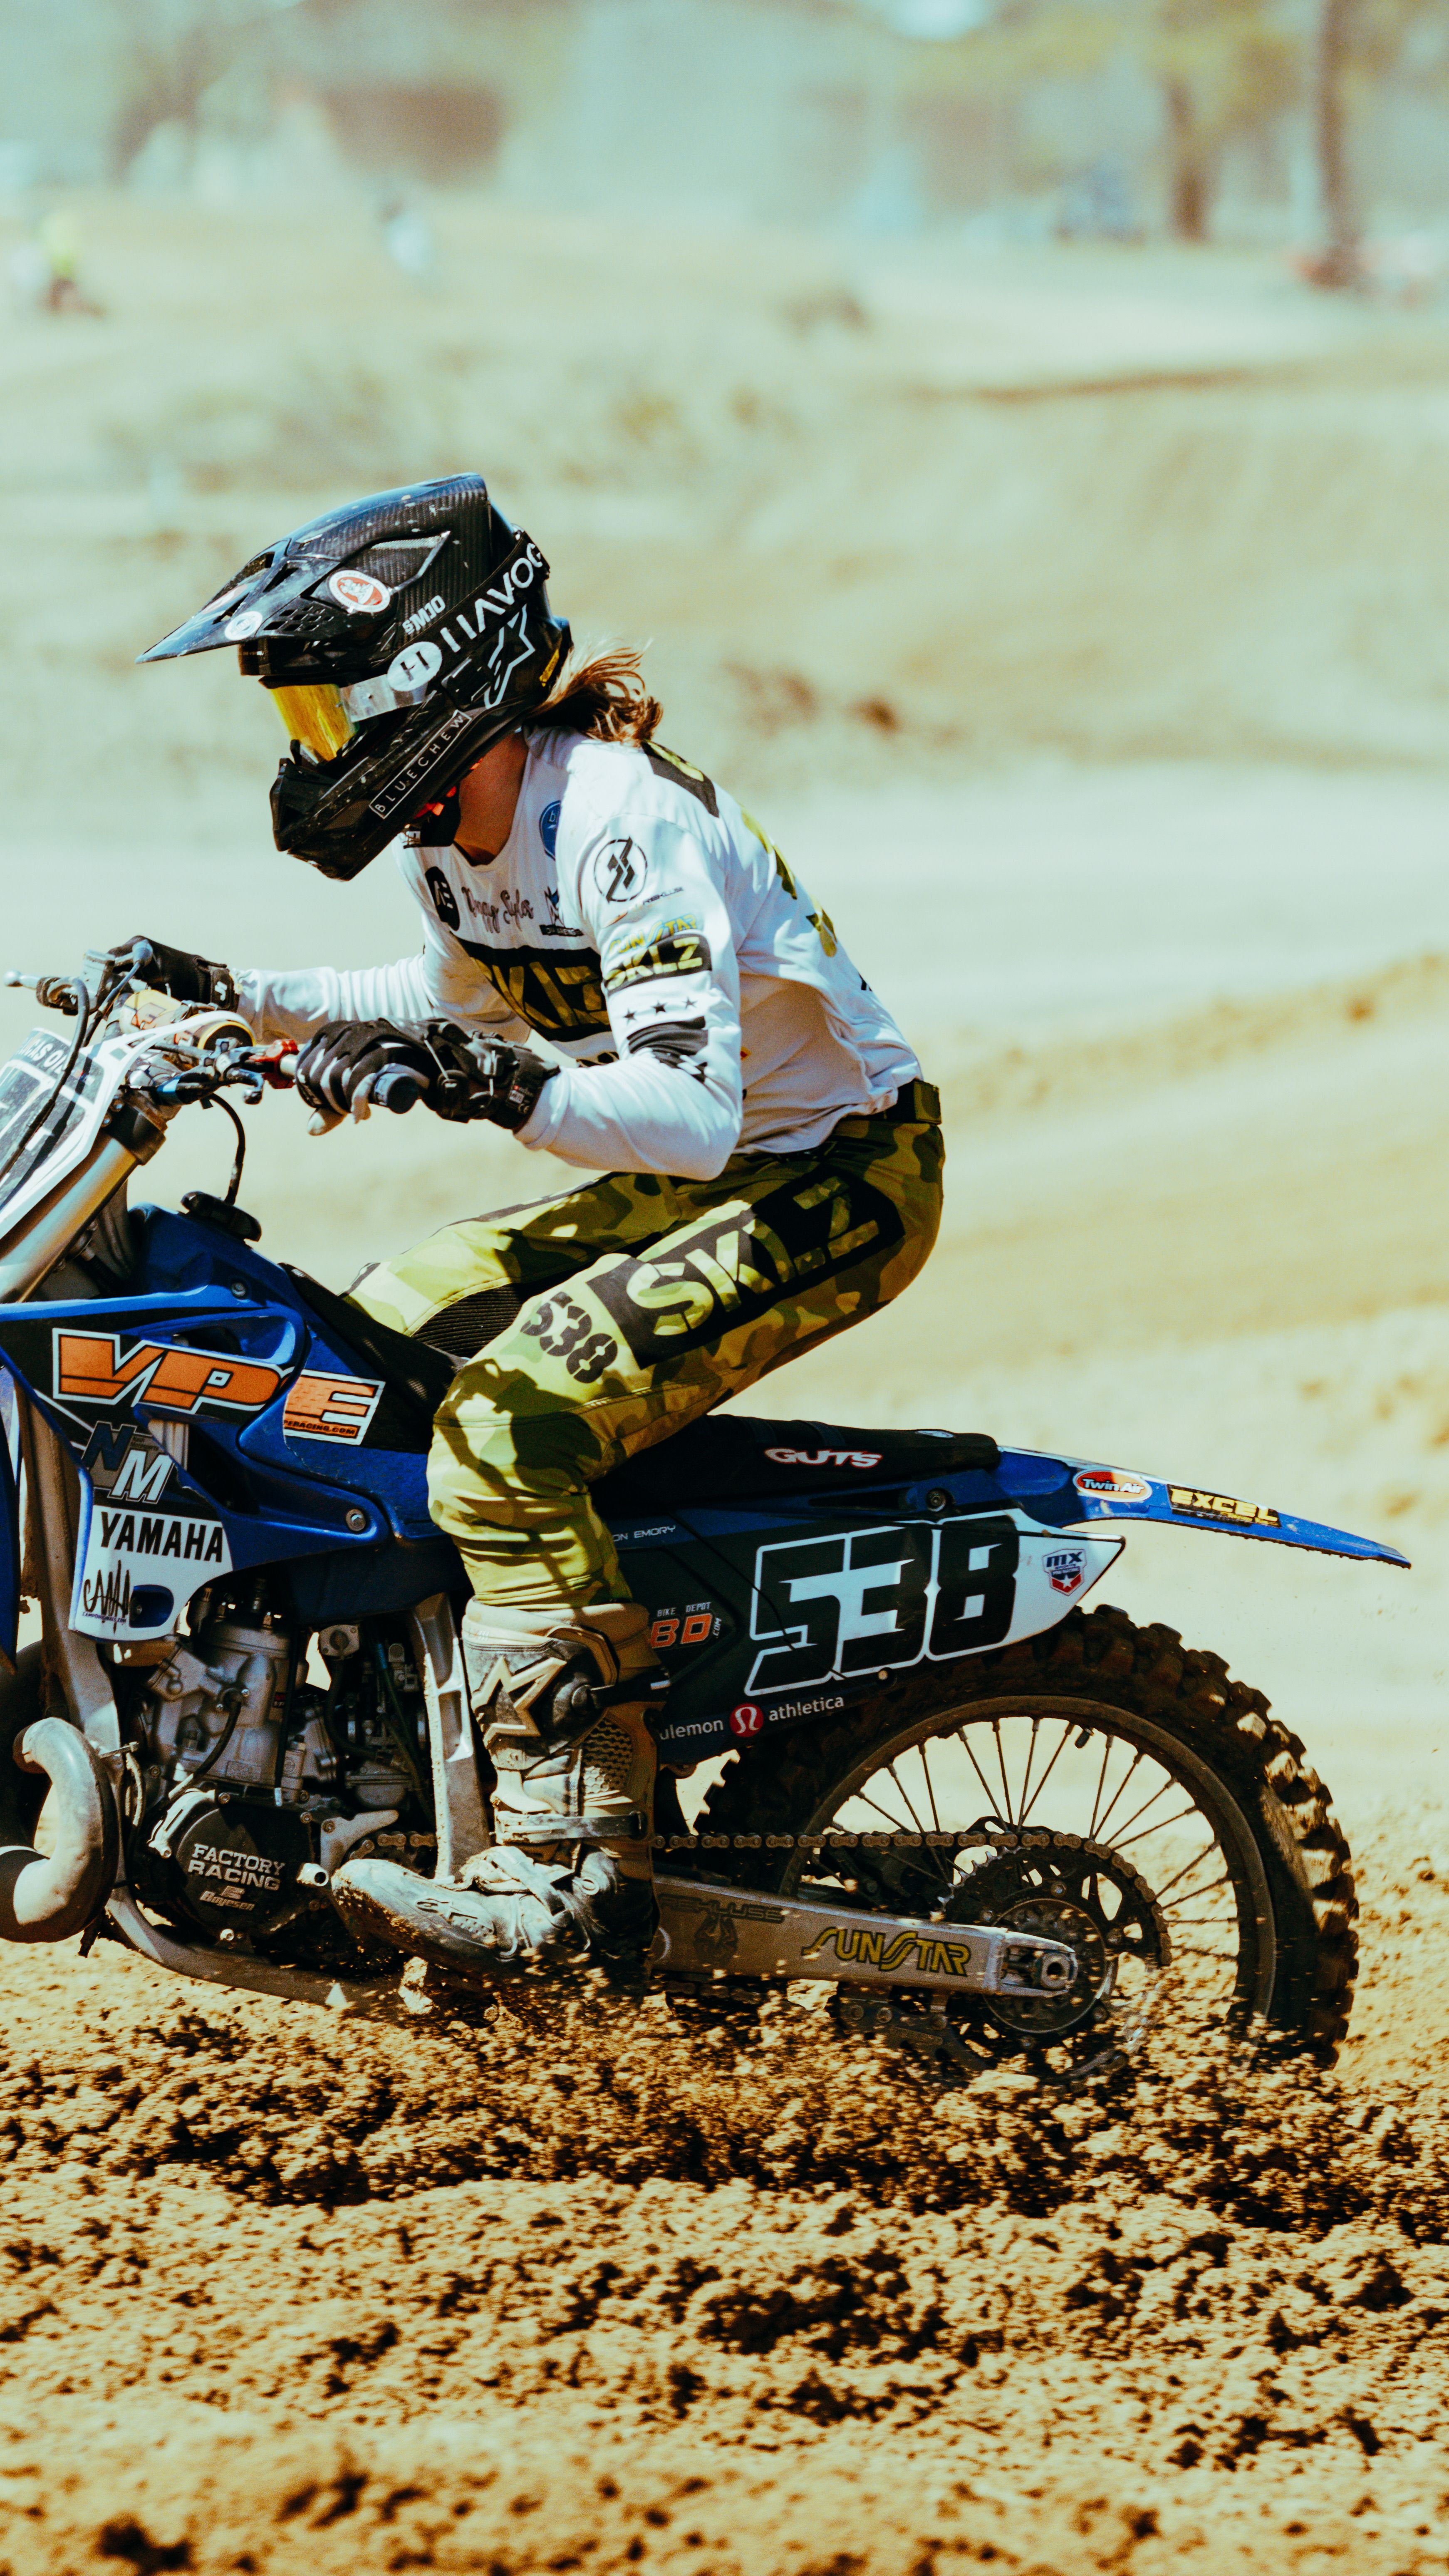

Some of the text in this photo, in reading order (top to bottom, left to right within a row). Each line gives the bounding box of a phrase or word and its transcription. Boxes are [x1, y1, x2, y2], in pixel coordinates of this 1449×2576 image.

[374, 715, 465, 813] BLUECHEW
[627, 1177, 879, 1336] SKLZ
[520, 1291, 618, 1383] 538
[765, 1447, 882, 1468] GUTS
[1083, 1478, 1145, 1494] Twin Air
[1170, 1488, 1278, 1522] EXCEL
[100, 1511, 223, 1562] YAMAHA
[633, 1525, 676, 1538] EMORY
[657, 1602, 711, 1617] BIKE DEPOT
[745, 1509, 1020, 1696] 538
[768, 1697, 844, 1721] athletica
[188, 1860, 281, 1891] RACING
[192, 1843, 286, 1875] FACTORY
[801, 1927, 971, 1977] SUNSTAR
